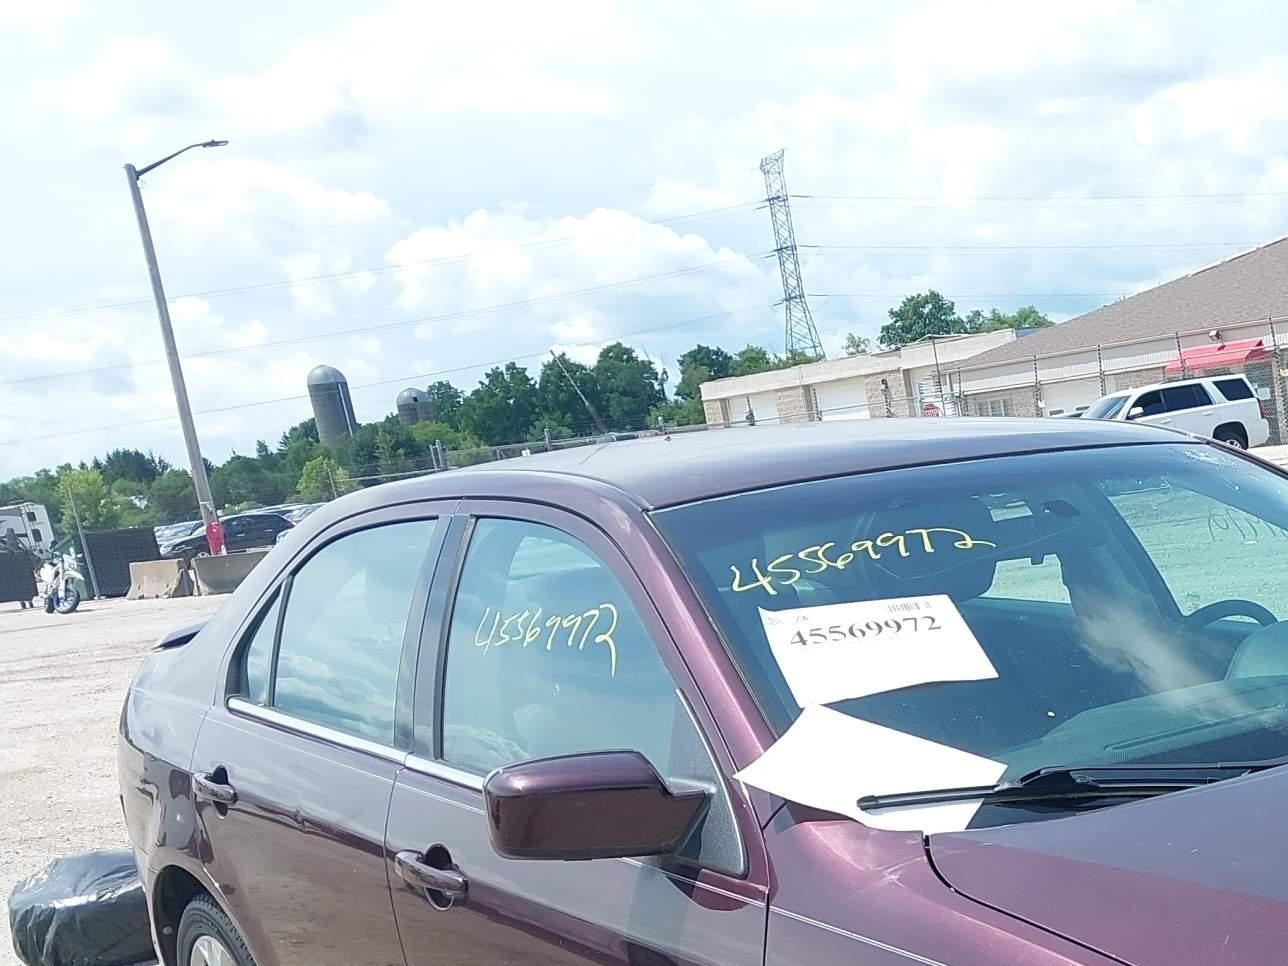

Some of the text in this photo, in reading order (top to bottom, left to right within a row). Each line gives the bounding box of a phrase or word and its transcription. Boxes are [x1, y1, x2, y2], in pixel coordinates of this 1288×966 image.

[729, 528, 997, 596] 45569972
[474, 602, 618, 679] 45569972
[790, 615, 942, 647] 45569972
